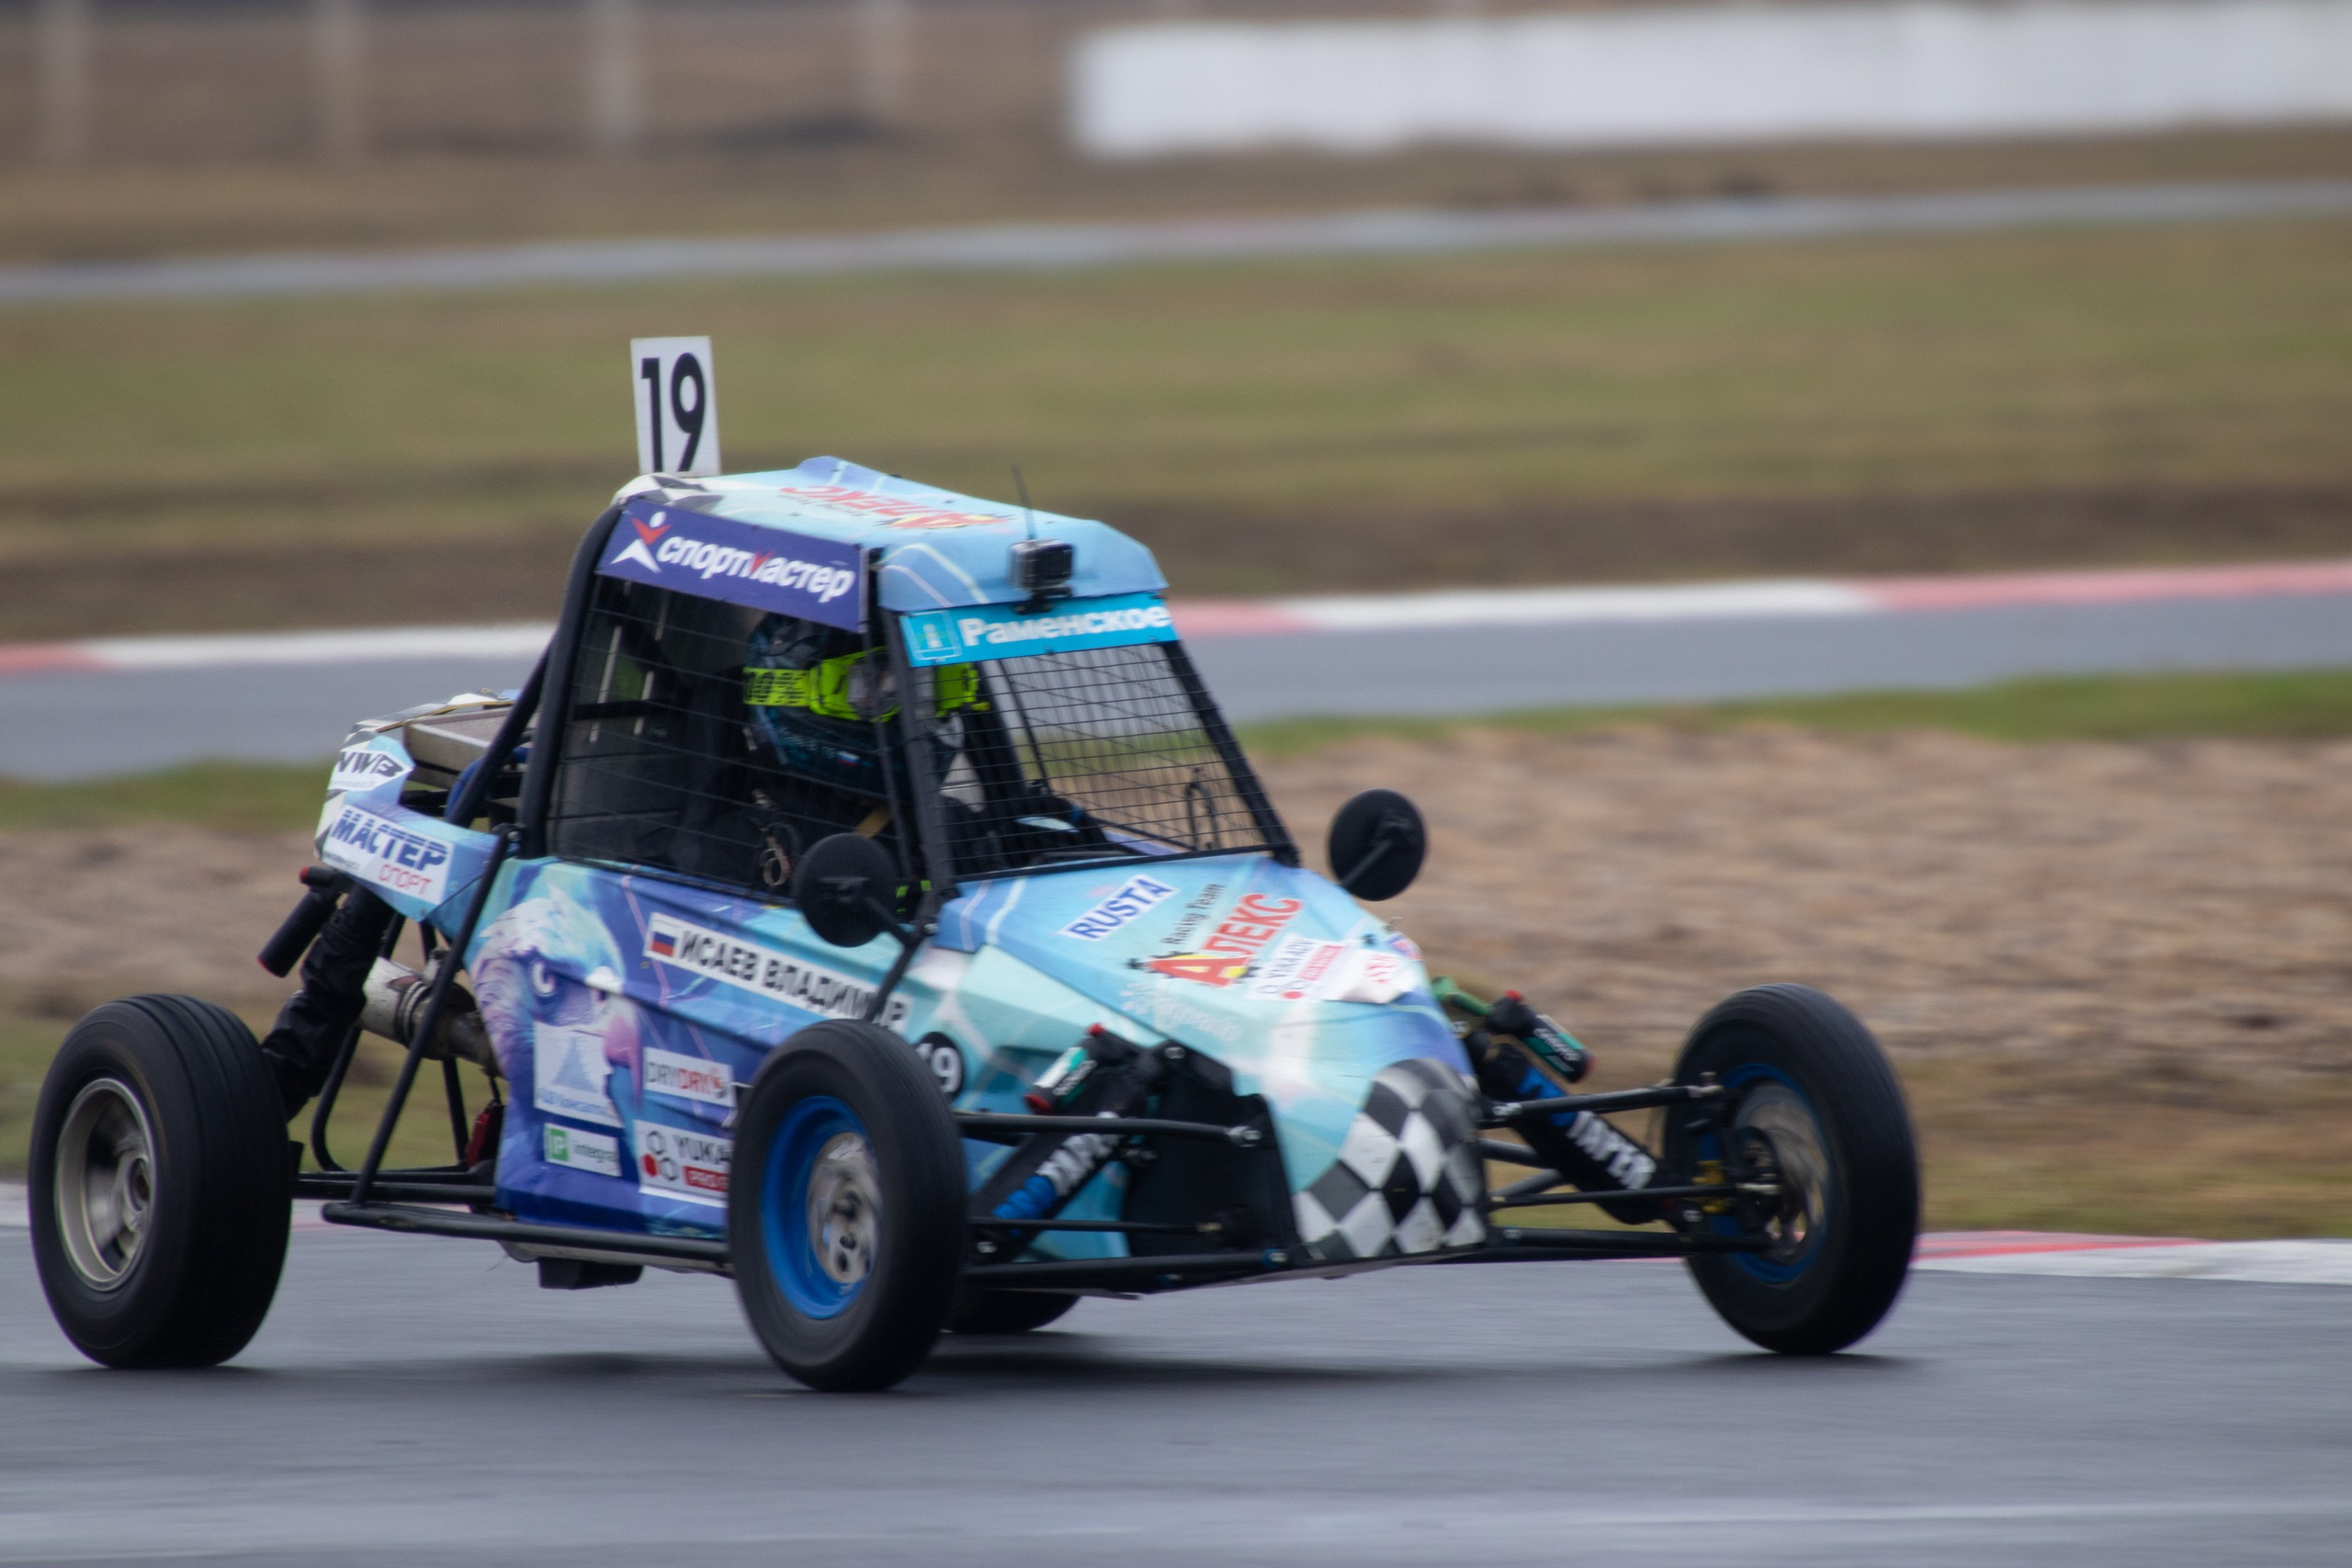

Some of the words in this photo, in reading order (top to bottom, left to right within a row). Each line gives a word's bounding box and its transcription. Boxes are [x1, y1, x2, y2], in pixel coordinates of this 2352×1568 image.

[641, 352, 707, 472] 19
[960, 605, 1173, 647] Раменское
[330, 809, 448, 872] МАСТЕР
[1069, 877, 1174, 940] RUSTA
[1148, 893, 1303, 987] АЛЕКС
[678, 929, 758, 982] ИСАЕВ
[764, 958, 906, 1028] ВЛАДИМР
